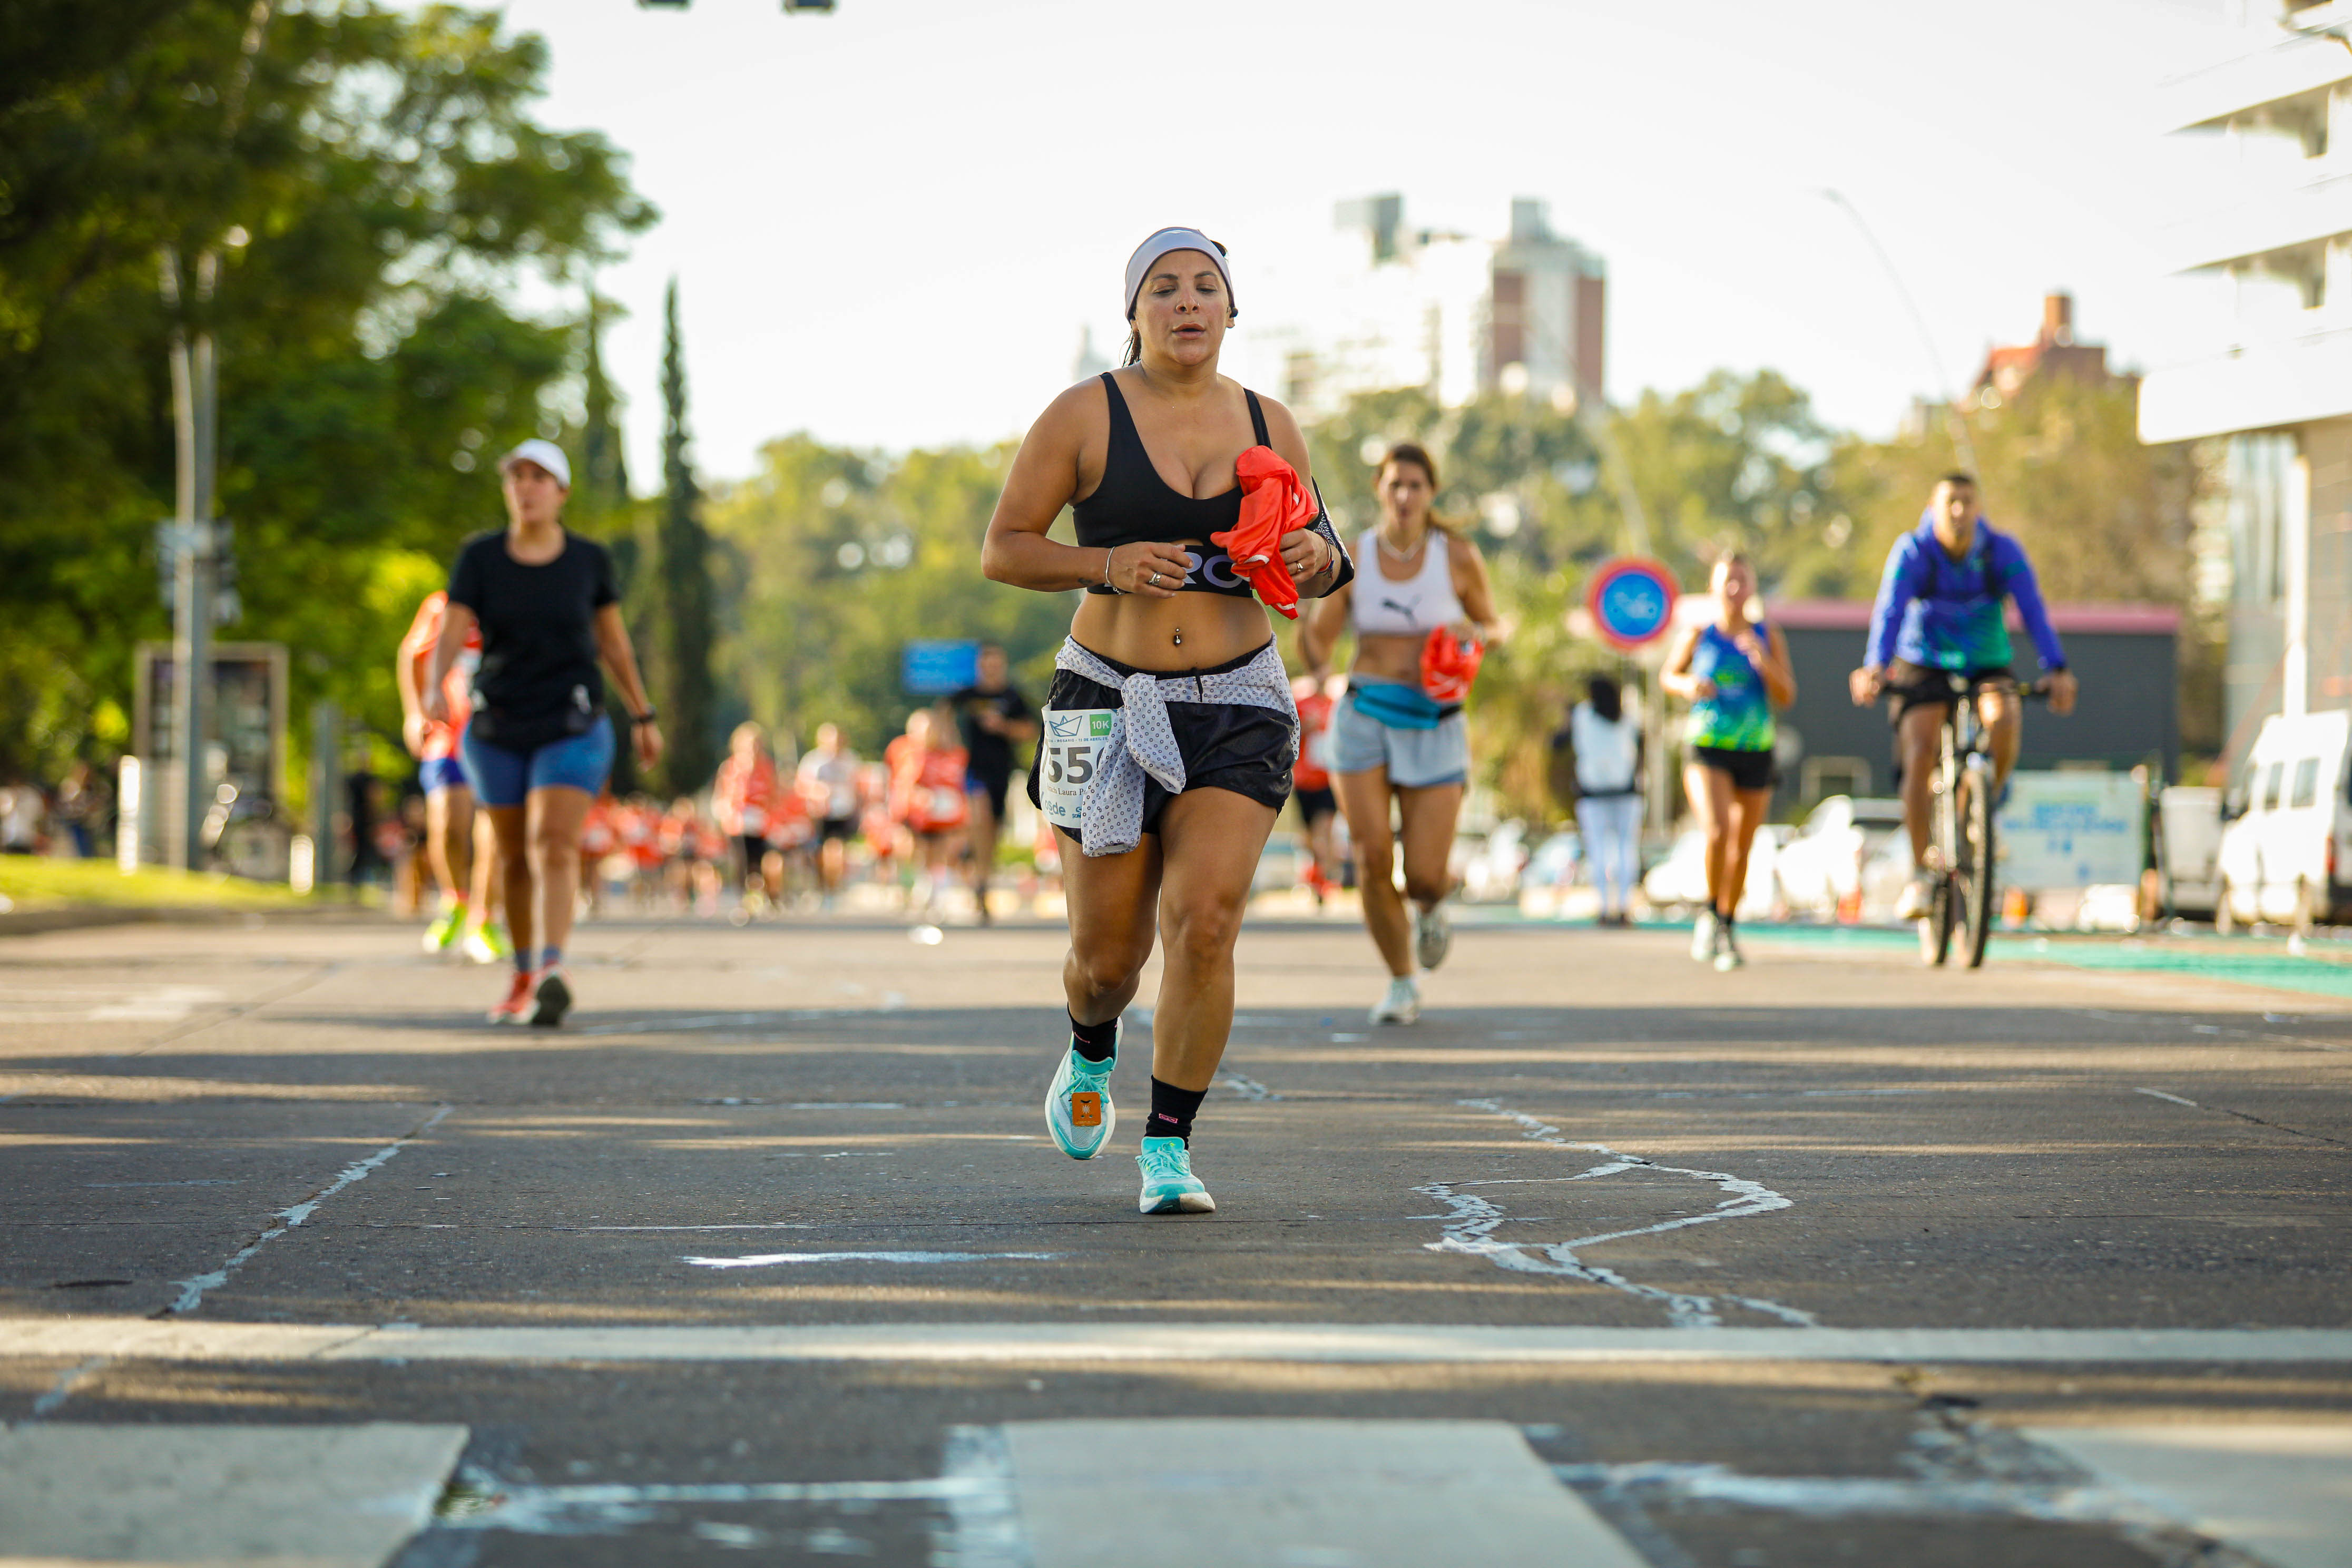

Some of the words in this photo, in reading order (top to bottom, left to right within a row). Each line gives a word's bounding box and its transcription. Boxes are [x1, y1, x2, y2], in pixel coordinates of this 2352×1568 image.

[1092, 720, 1110, 730] 10K
[1058, 788, 1077, 797] Laura
[1045, 800, 1066, 817] osde
